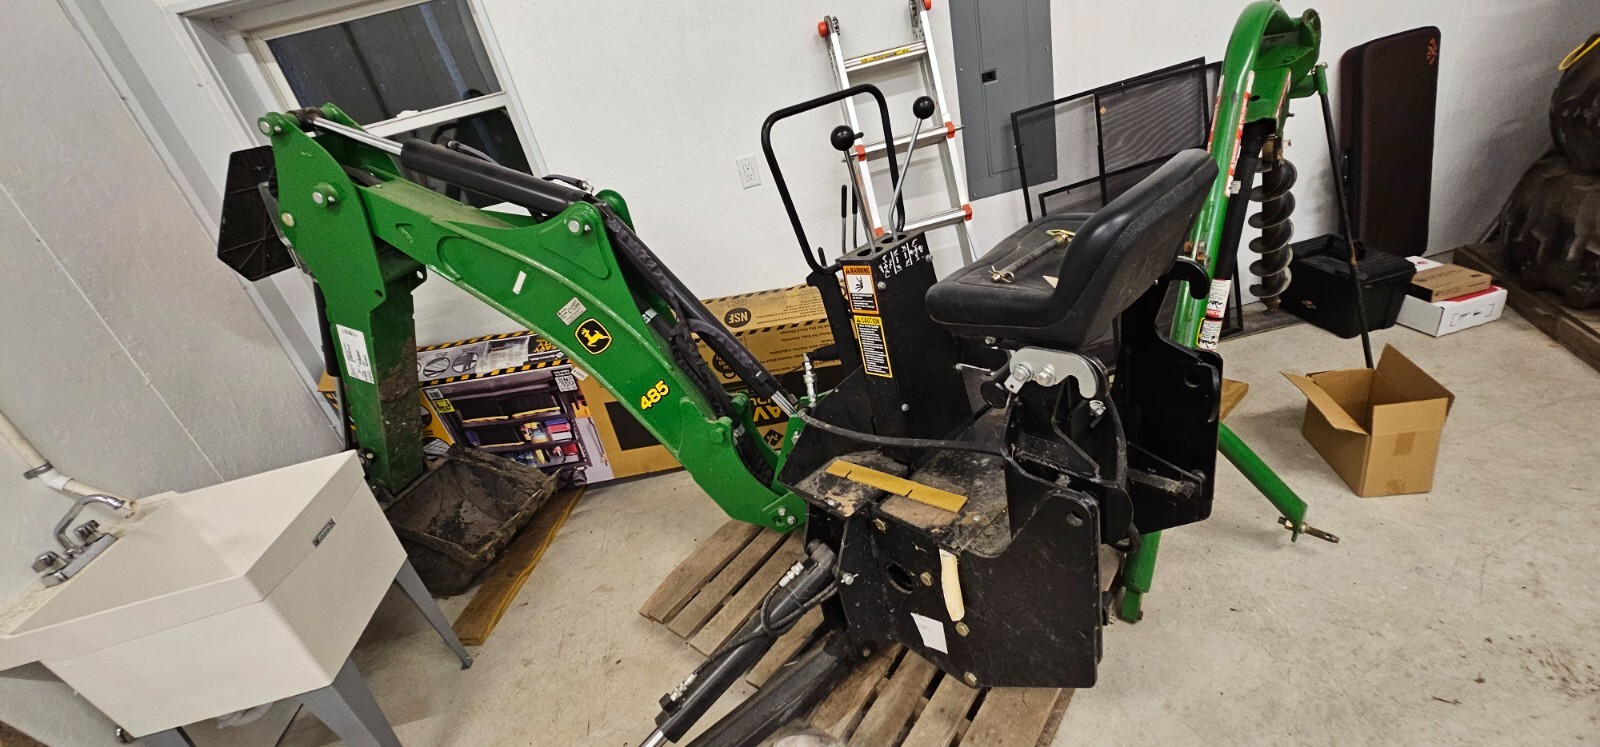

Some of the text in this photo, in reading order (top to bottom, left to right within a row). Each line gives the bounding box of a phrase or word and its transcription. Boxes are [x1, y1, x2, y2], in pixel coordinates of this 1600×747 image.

[849, 266, 870, 274] WARNING
[728, 311, 748, 324] NSF
[861, 317, 880, 325] CAUTION
[640, 379, 670, 410] 485
